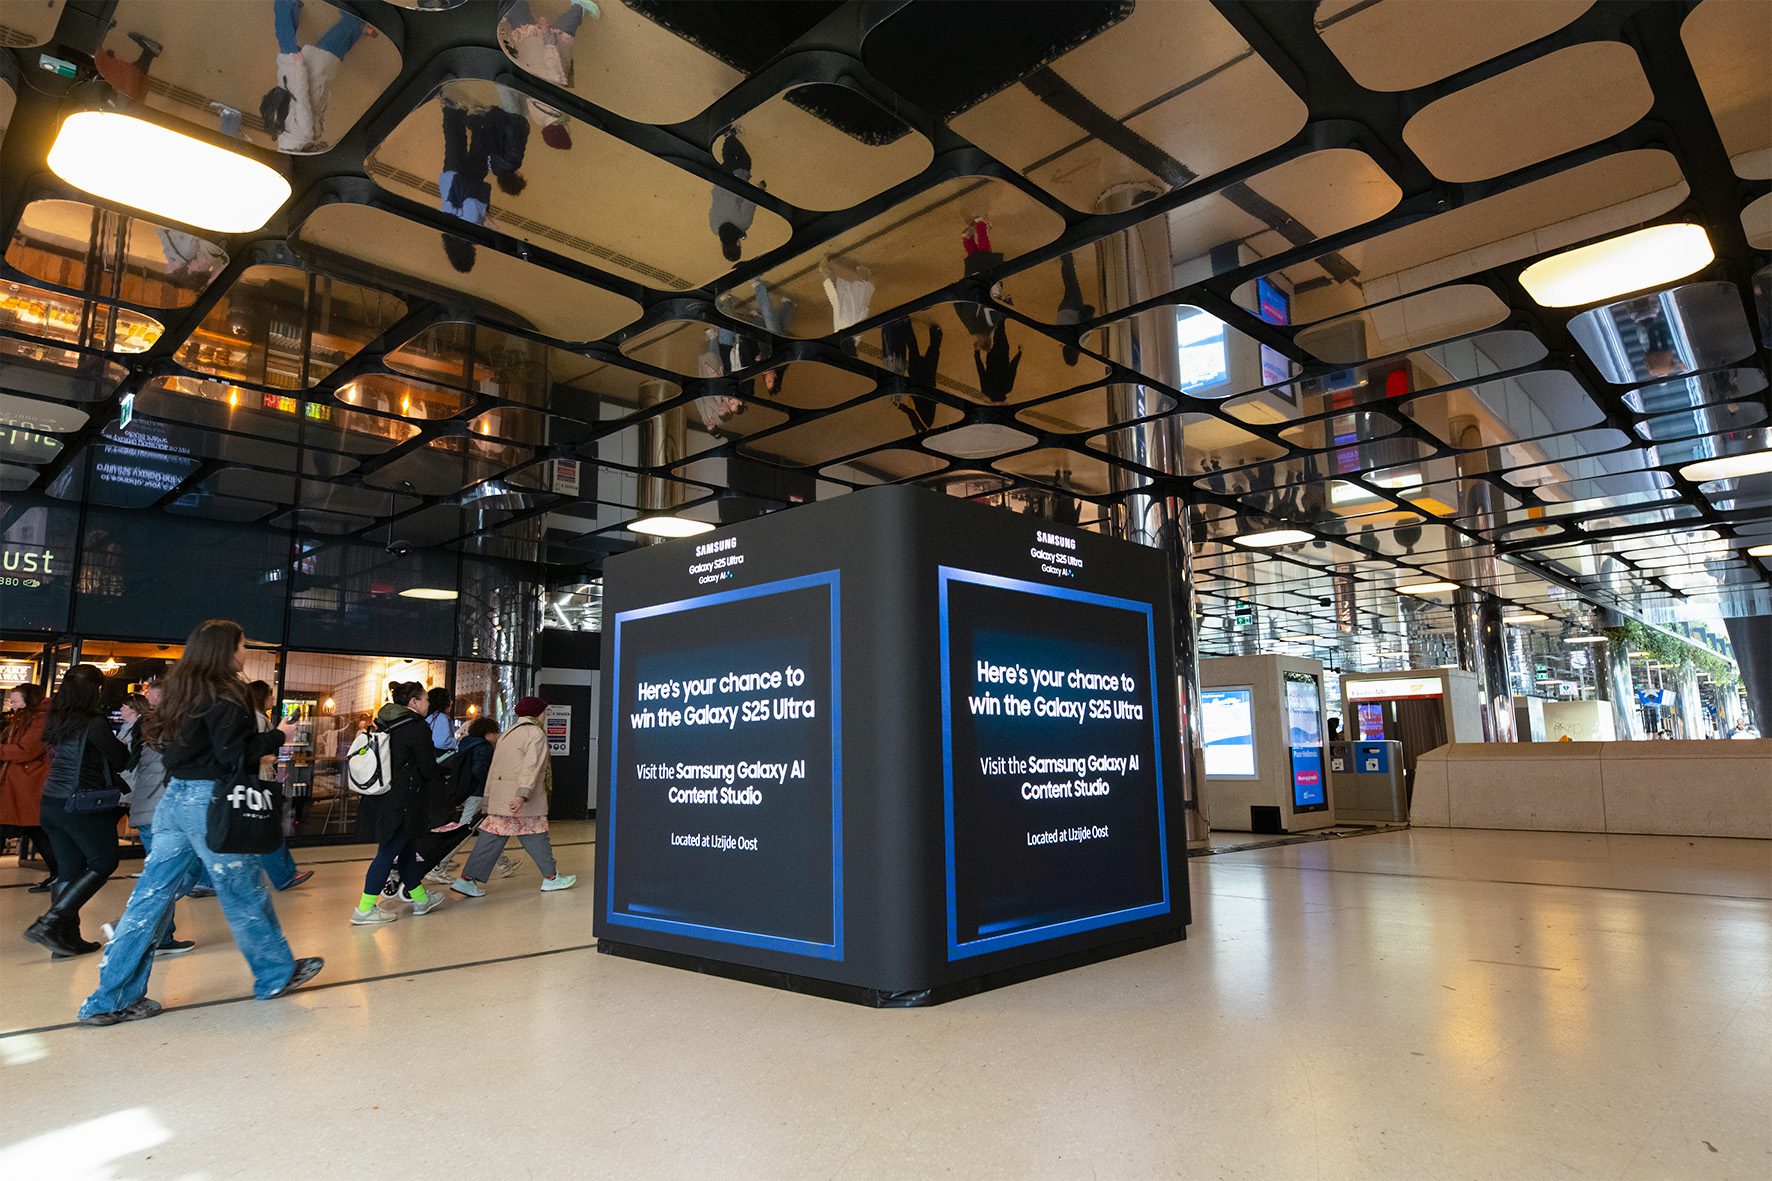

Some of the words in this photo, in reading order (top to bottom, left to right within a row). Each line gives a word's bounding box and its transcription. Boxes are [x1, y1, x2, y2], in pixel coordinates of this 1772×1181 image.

[696, 537, 736, 557] SAMSUNG
[1036, 530, 1076, 550] SAMSUNG
[3, 550, 54, 574] ust
[689, 562, 713, 575] Galaxy
[714, 558, 727, 570] S25
[727, 555, 744, 566] Ultra
[1030, 547, 1056, 564] Galaxy
[1056, 553, 1067, 565] S25
[1067, 555, 1083, 568] Ultra
[699, 574, 720, 585] Galaxy
[720, 572, 727, 581] AI
[1041, 563, 1062, 577] Galaxy
[1062, 568, 1069, 577] AI
[638, 679, 680, 701] Here's
[682, 678, 717, 704] your
[719, 671, 782, 693] chance
[785, 665, 805, 687] to
[977, 660, 1028, 685] Here's
[1030, 669, 1065, 692] your
[1067, 669, 1119, 691] chance
[1121, 673, 1134, 692] to
[631, 708, 655, 729] win
[657, 708, 681, 727] the
[684, 704, 739, 729] Galaxy
[742, 699, 770, 722] S25
[773, 697, 815, 720] Ultra
[968, 691, 1000, 715] win
[1003, 694, 1031, 716] the
[1034, 696, 1086, 724] Galaxy
[1089, 699, 1111, 718] S25
[1113, 700, 1143, 720] Ultra
[637, 764, 657, 779] Visit
[658, 763, 675, 779] the
[676, 763, 735, 784] Samsung
[737, 761, 788, 784] Galaxy
[790, 760, 805, 778] AI
[980, 757, 1006, 775] Visit
[1008, 756, 1027, 774] the
[1029, 756, 1086, 777] Samsung
[1088, 755, 1127, 776] Galaxy
[1129, 755, 1139, 770] AI
[668, 787, 718, 804] Content
[720, 785, 762, 805] Studio
[1021, 780, 1072, 800] Content
[1074, 778, 1109, 797] Studio
[671, 833, 700, 846] Located
[701, 835, 710, 847] at
[738, 836, 758, 850] Oost
[1027, 829, 1058, 845] Located
[1059, 829, 1067, 842] at
[1092, 825, 1108, 838] Oost
